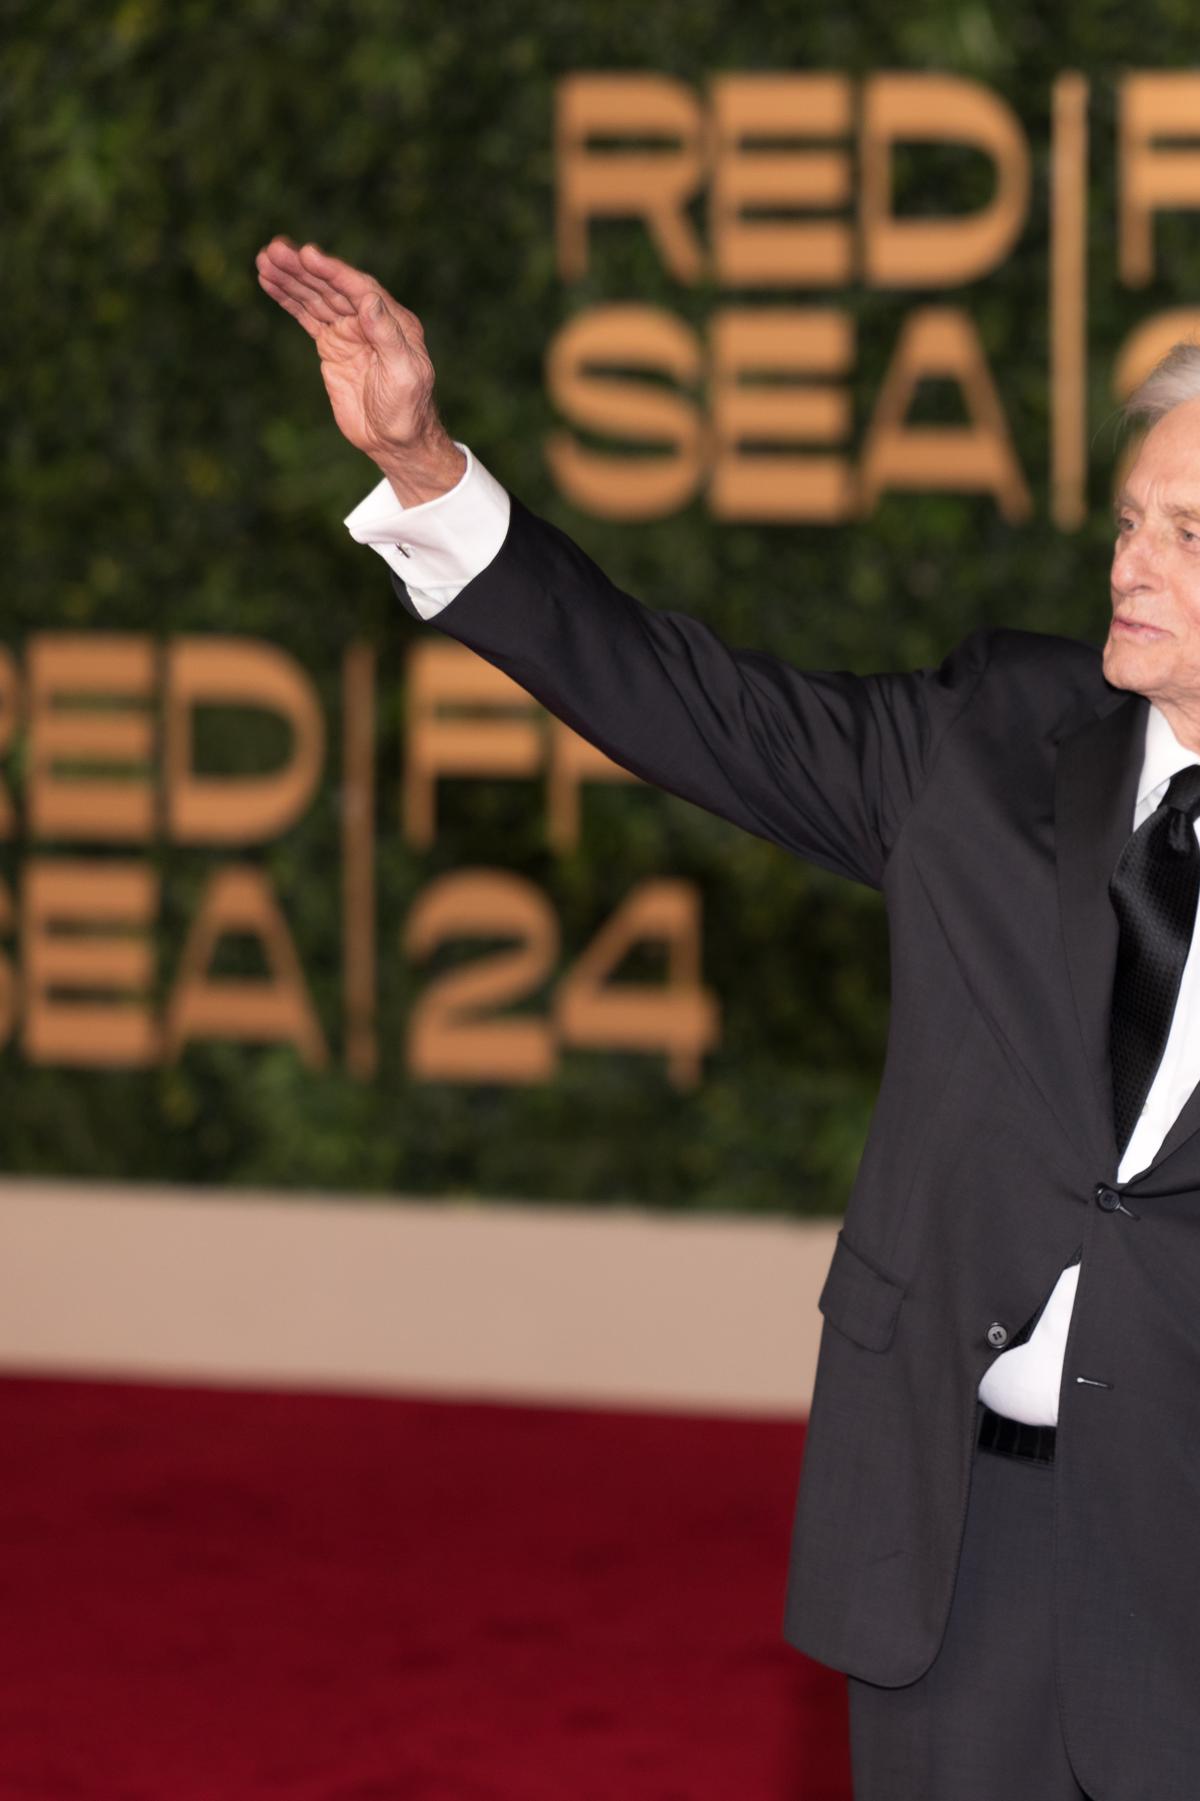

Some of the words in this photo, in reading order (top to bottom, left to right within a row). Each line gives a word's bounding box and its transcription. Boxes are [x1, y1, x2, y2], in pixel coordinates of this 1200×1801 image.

[554, 71, 1031, 288] RED
[545, 304, 1032, 525] SEA
[0, 632, 326, 846] ED
[0, 858, 330, 1075] EA
[404, 866, 720, 1092] 24
